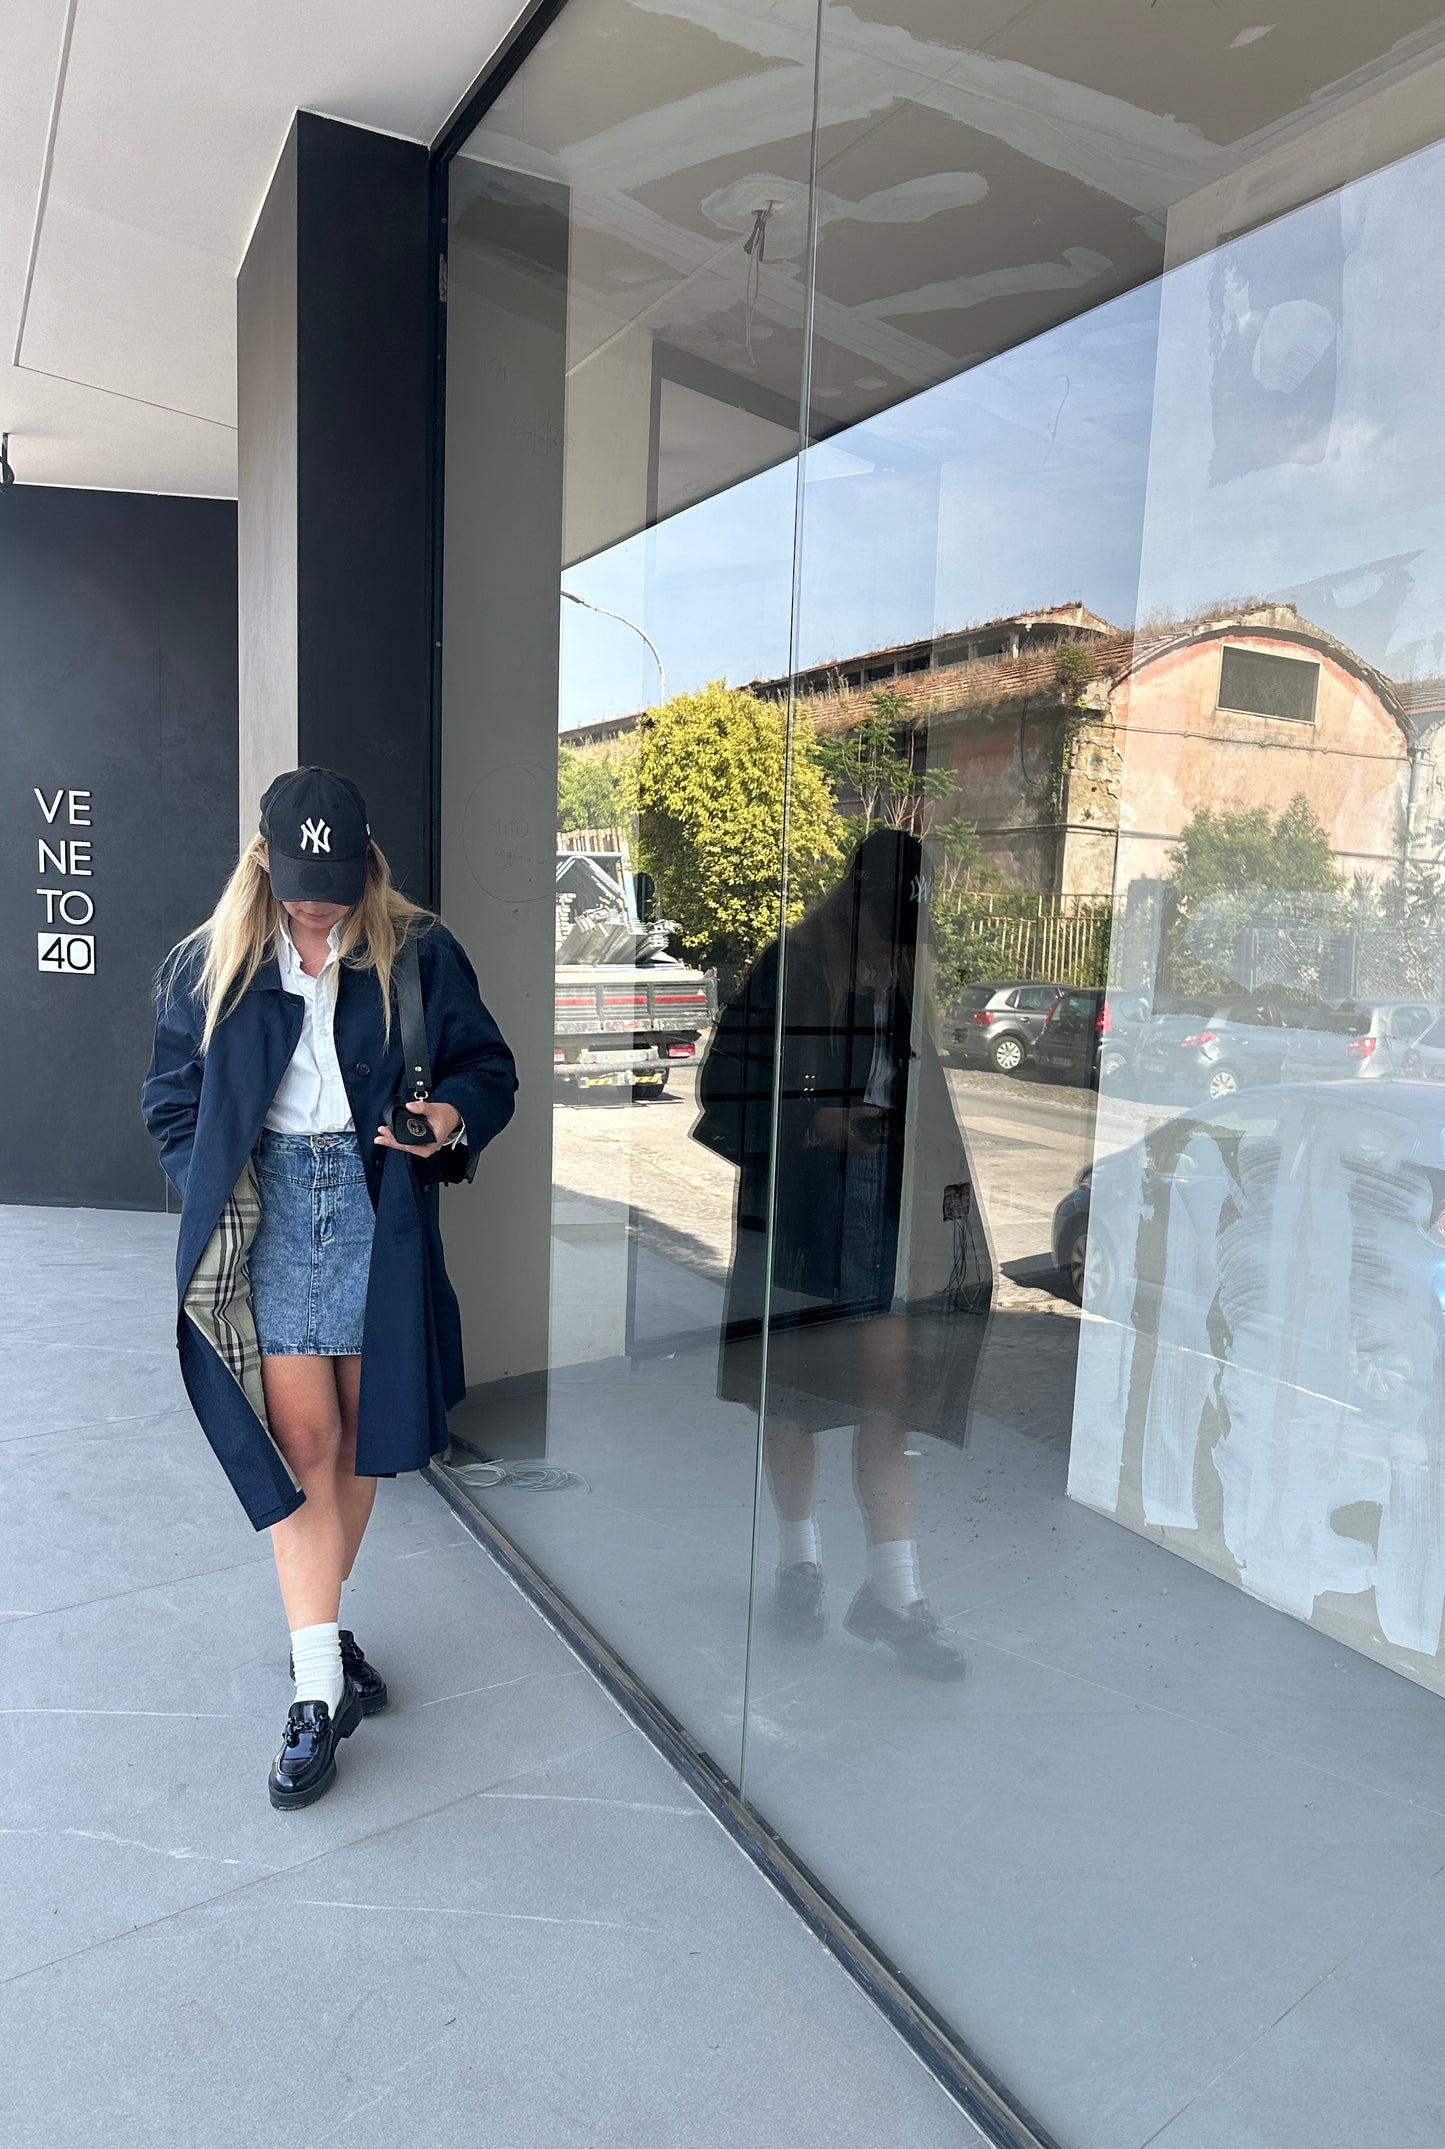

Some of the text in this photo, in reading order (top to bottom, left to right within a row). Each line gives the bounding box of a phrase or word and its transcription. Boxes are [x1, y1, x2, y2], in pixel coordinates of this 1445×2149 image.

[33, 788, 91, 825] VE
[300, 817, 331, 853] NY
[38, 839, 92, 875] NE
[36, 888, 94, 925] TO
[41, 936, 91, 970] 40
